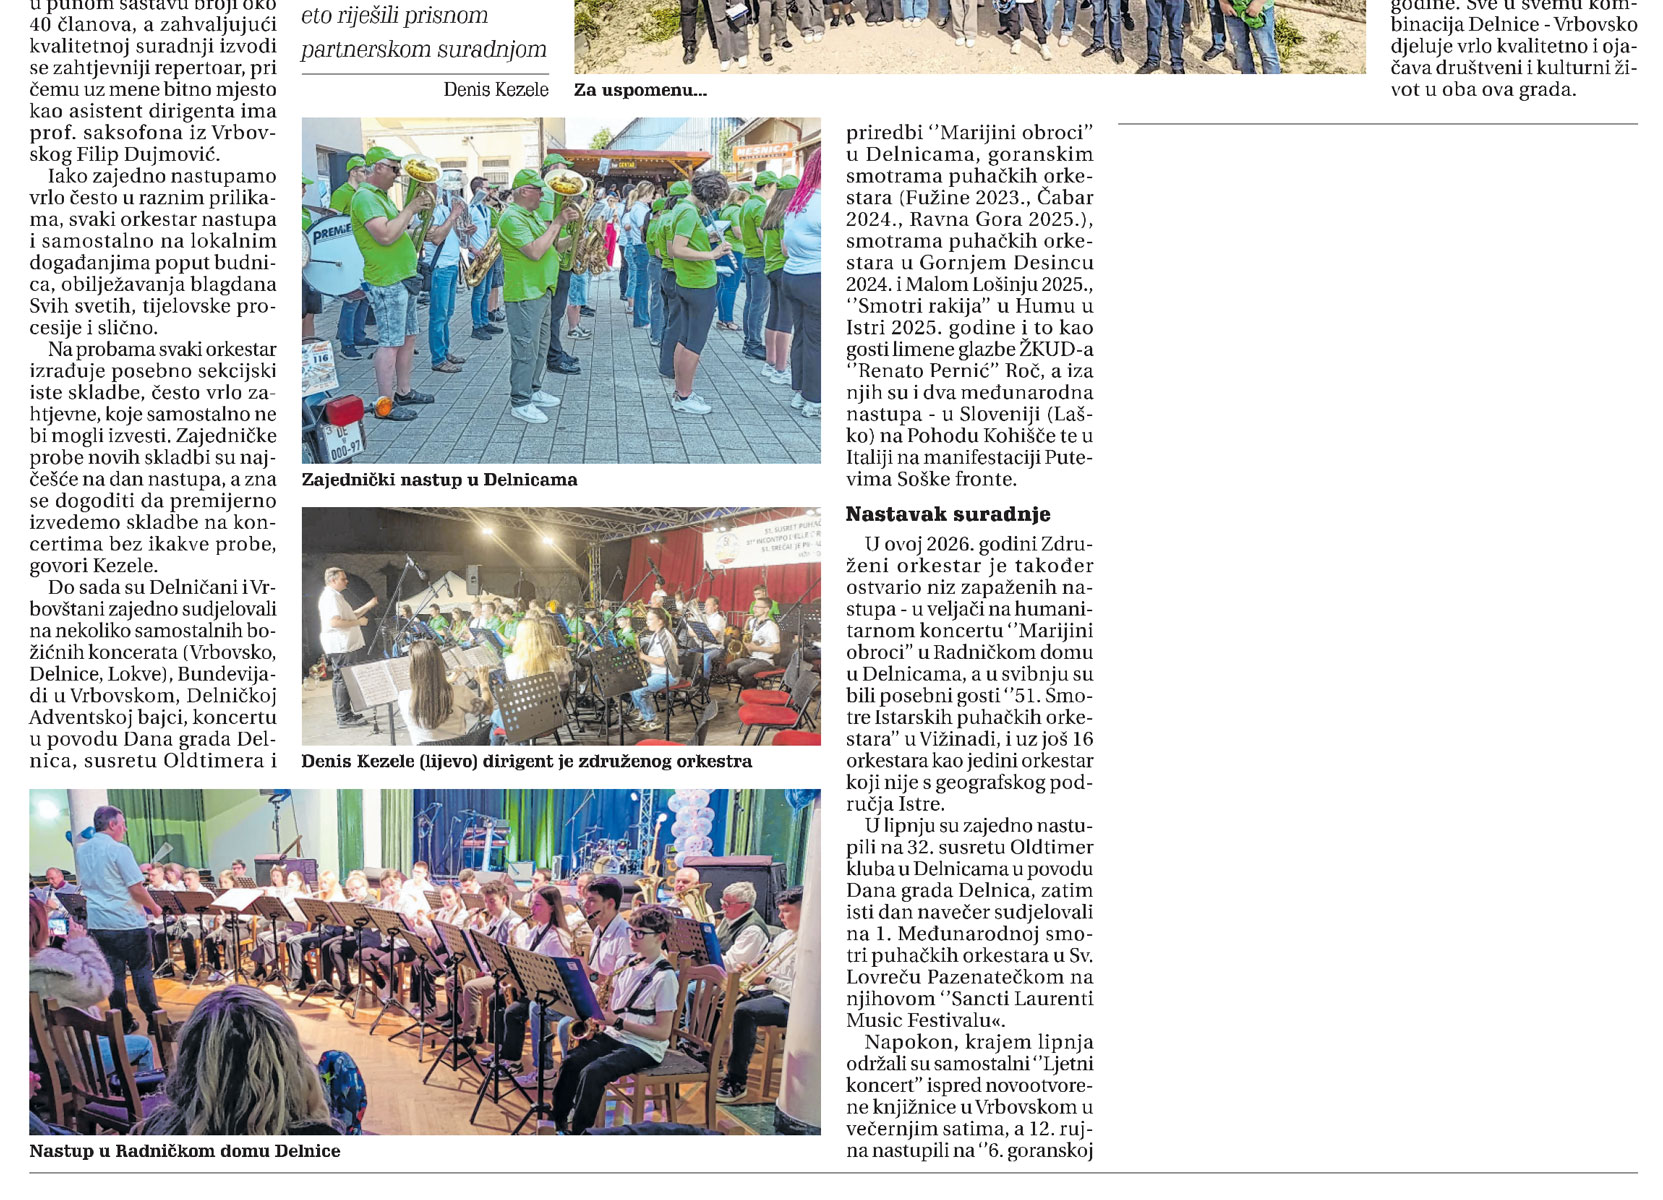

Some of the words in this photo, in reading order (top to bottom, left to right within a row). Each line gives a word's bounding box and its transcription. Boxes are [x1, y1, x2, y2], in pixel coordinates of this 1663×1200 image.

[302, 8, 332, 24] eto
[337, 5, 398, 28] riješili
[403, 6, 488, 28] prisnom
[300, 40, 431, 62] partnerskom
[438, 40, 546, 63] suradnjom
[444, 82, 490, 97] Denis
[496, 82, 549, 97] Kezele
[574, 83, 596, 96] Za
[602, 86, 707, 99] uspomenu...
[49, 167, 87, 183] Iako
[93, 167, 165, 188] zajedno
[171, 170, 276, 187] nastupamo
[847, 192, 892, 205] stara
[900, 190, 969, 207] (Fužine
[976, 190, 1030, 207] 2023.,
[1038, 186, 1094, 204] Čabar
[846, 212, 902, 229] 2024.,
[910, 212, 969, 226] Ravna
[976, 211, 1022, 226] Gora
[1029, 212, 1092, 229] 2025.),
[313, 354, 329, 363] 116
[302, 472, 395, 489] Zajednički
[401, 474, 462, 489] nastup
[467, 476, 478, 486] u
[484, 473, 578, 486] Delnicama
[846, 506, 947, 522] Nastavak
[954, 506, 1050, 525] suradnje
[30, 644, 84, 659] žićnih
[88, 644, 178, 659] koncerata
[184, 644, 275, 662] (Vrbovsko,
[30, 665, 103, 683] Delnice,
[108, 665, 173, 683] Lokve),
[178, 665, 275, 686] Bundevija-
[302, 754, 351, 768] Denis
[357, 754, 414, 768] Kezele
[420, 754, 477, 771] (lijevo)
[483, 754, 554, 770] dirigent
[558, 754, 573, 770] je
[579, 754, 672, 770] združenog
[677, 754, 753, 768] orkestra
[847, 1012, 902, 1027] Music
[908, 1012, 1005, 1027] Festivalu«.
[30, 1144, 94, 1160] Nastup
[99, 1147, 110, 1157] u
[116, 1144, 215, 1157] Radničkom
[221, 1144, 270, 1157] domu
[275, 1144, 340, 1157] Delnice
